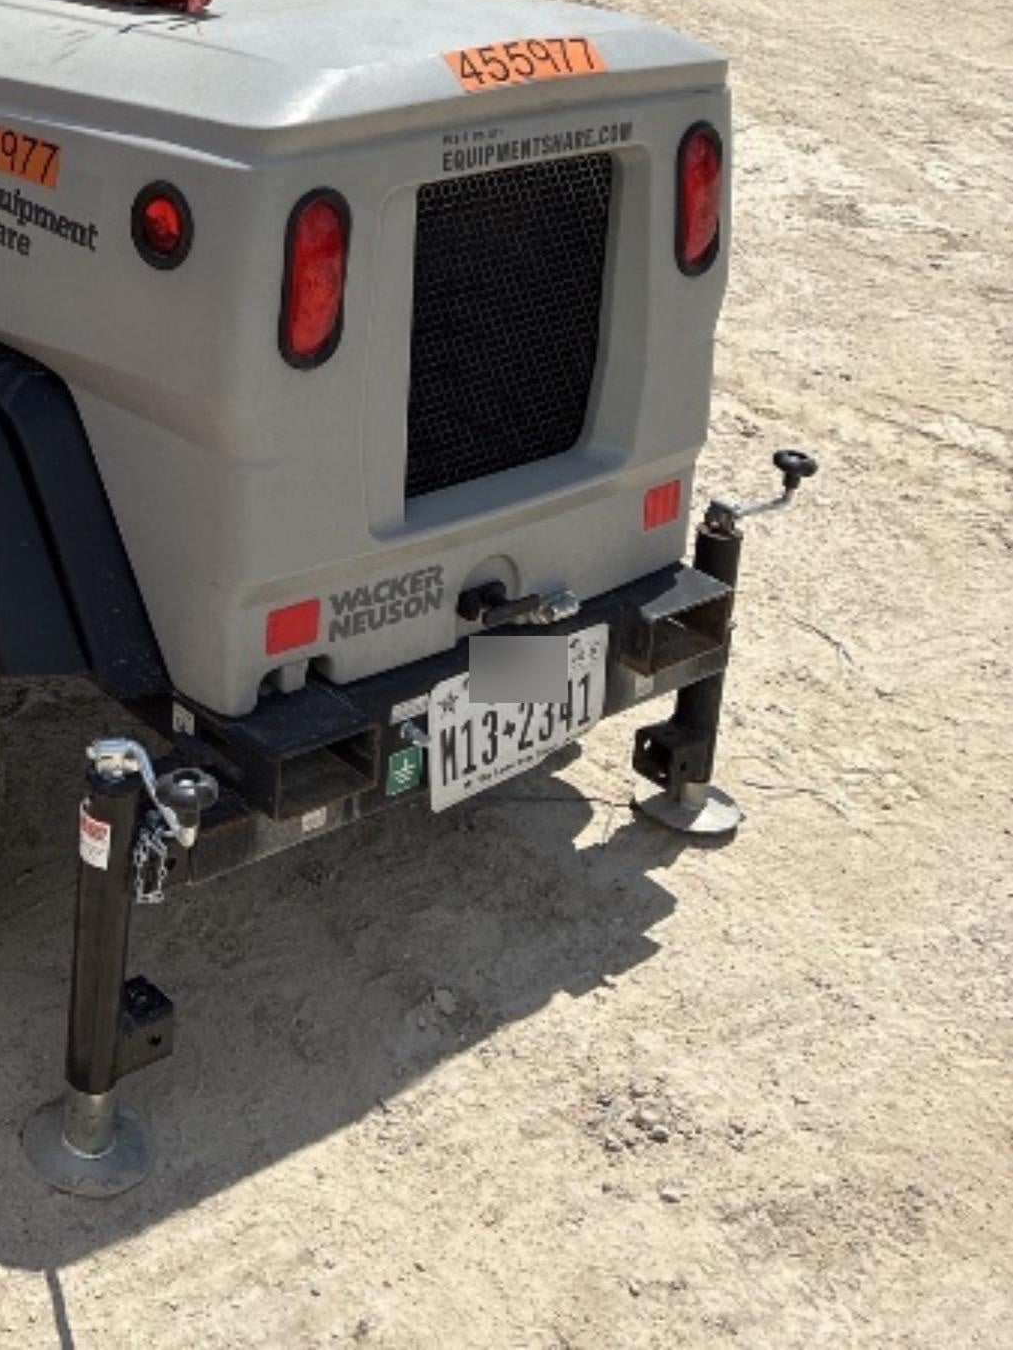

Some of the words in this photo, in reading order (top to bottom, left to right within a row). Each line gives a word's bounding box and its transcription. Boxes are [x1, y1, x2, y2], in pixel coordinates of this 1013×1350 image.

[459, 36, 596, 85] 455977
[442, 119, 634, 172] EQUIPMENTSHARE.COM
[328, 587, 445, 643] NEUSON
[329, 564, 445, 616] WACKER
